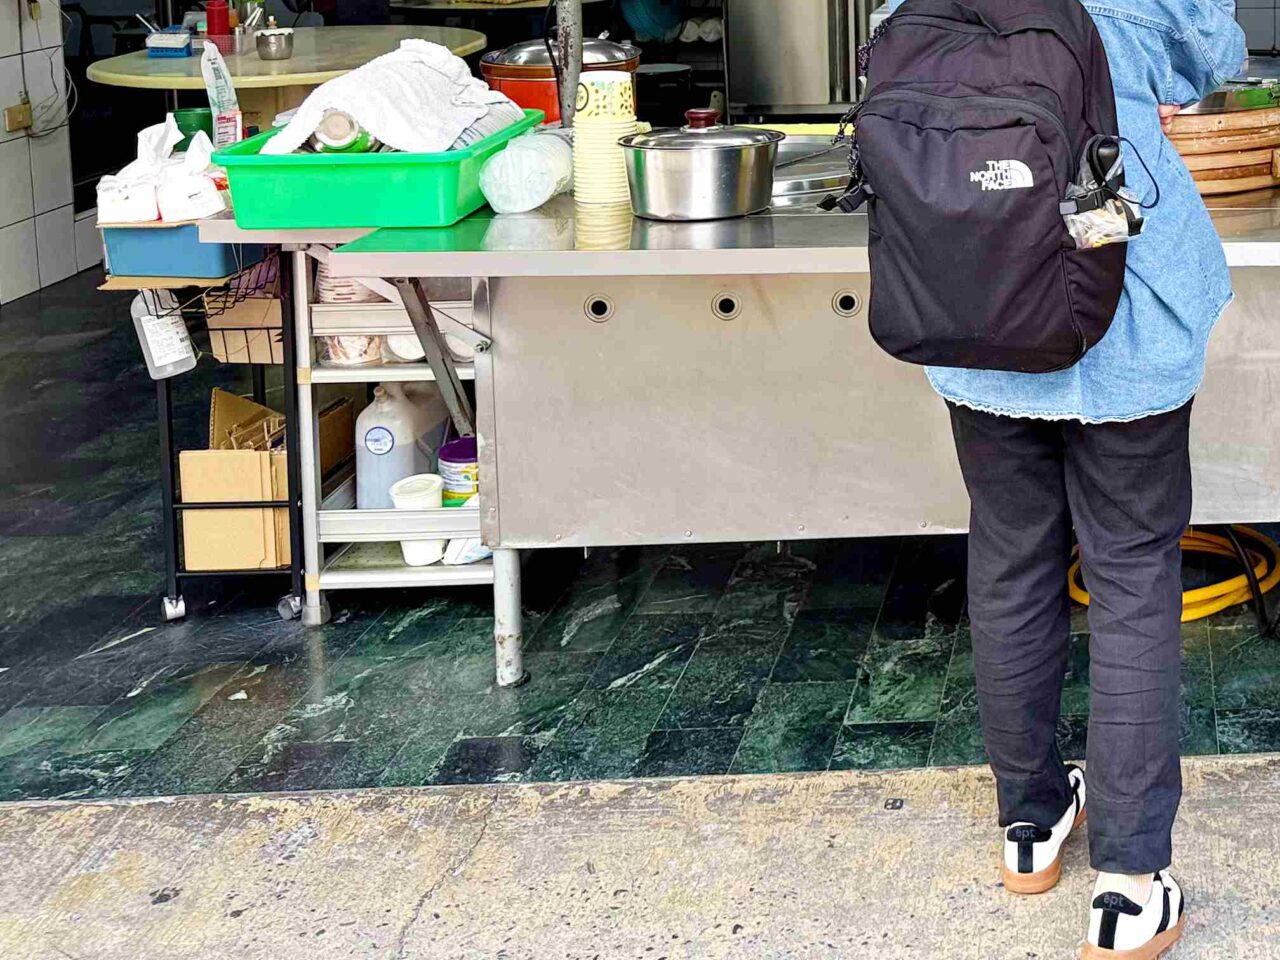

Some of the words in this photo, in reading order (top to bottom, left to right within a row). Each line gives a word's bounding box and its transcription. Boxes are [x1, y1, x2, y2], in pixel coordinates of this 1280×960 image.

[986, 160, 1010, 171] THE
[970, 170, 1011, 182] NORTH
[982, 180, 1012, 191] FACE
